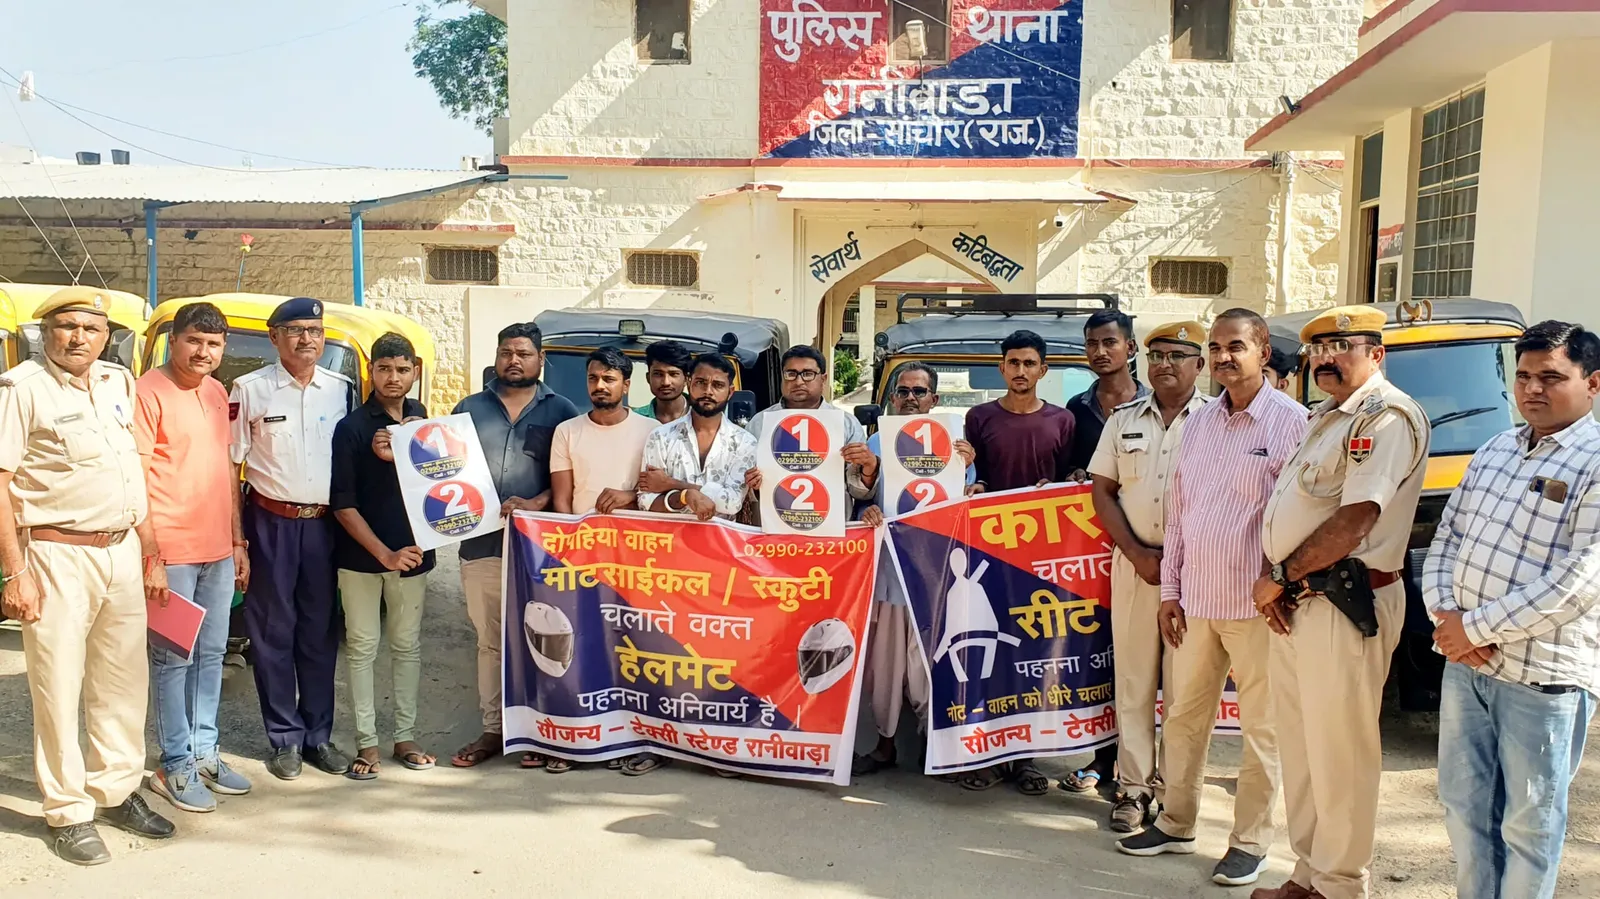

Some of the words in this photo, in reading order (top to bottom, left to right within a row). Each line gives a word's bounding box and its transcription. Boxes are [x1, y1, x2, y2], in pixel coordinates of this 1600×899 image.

[767, 0, 881, 62] पुलिस
[968, 5, 1068, 44] थाना
[809, 231, 862, 283] सेवार्थ
[426, 426, 449, 458] 1
[791, 418, 809, 451] 1
[914, 423, 933, 455] 1
[777, 457, 822, 465] 02990-232100
[440, 483, 470, 516] 2
[790, 478, 814, 510] 2
[780, 514, 823, 523] 02990-232100
[970, 492, 1103, 550] कार
[623, 530, 674, 553] वाहन
[744, 539, 867, 558] 02990-232100
[748, 566, 833, 612] स्कुटी
[600, 601, 676, 635] चलाते
[688, 613, 754, 641] वक्त
[1009, 589, 1101, 640] सीट
[614, 635, 737, 691] हेलमेट
[1014, 655, 1081, 678] पहनना
[577, 687, 649, 712] पहनना
[658, 692, 749, 723] अनिवार्य
[759, 695, 778, 728] है
[987, 694, 1019, 715] वाहन
[1022, 686, 1043, 708] को
[1046, 683, 1073, 707] धीरे
[536, 717, 602, 743] सौजन्य
[630, 716, 679, 745] टेक्सी
[683, 727, 739, 755] स्टेण्ड
[744, 733, 831, 766] रानीवाड़ा
[960, 726, 1032, 755] सौजन्य
